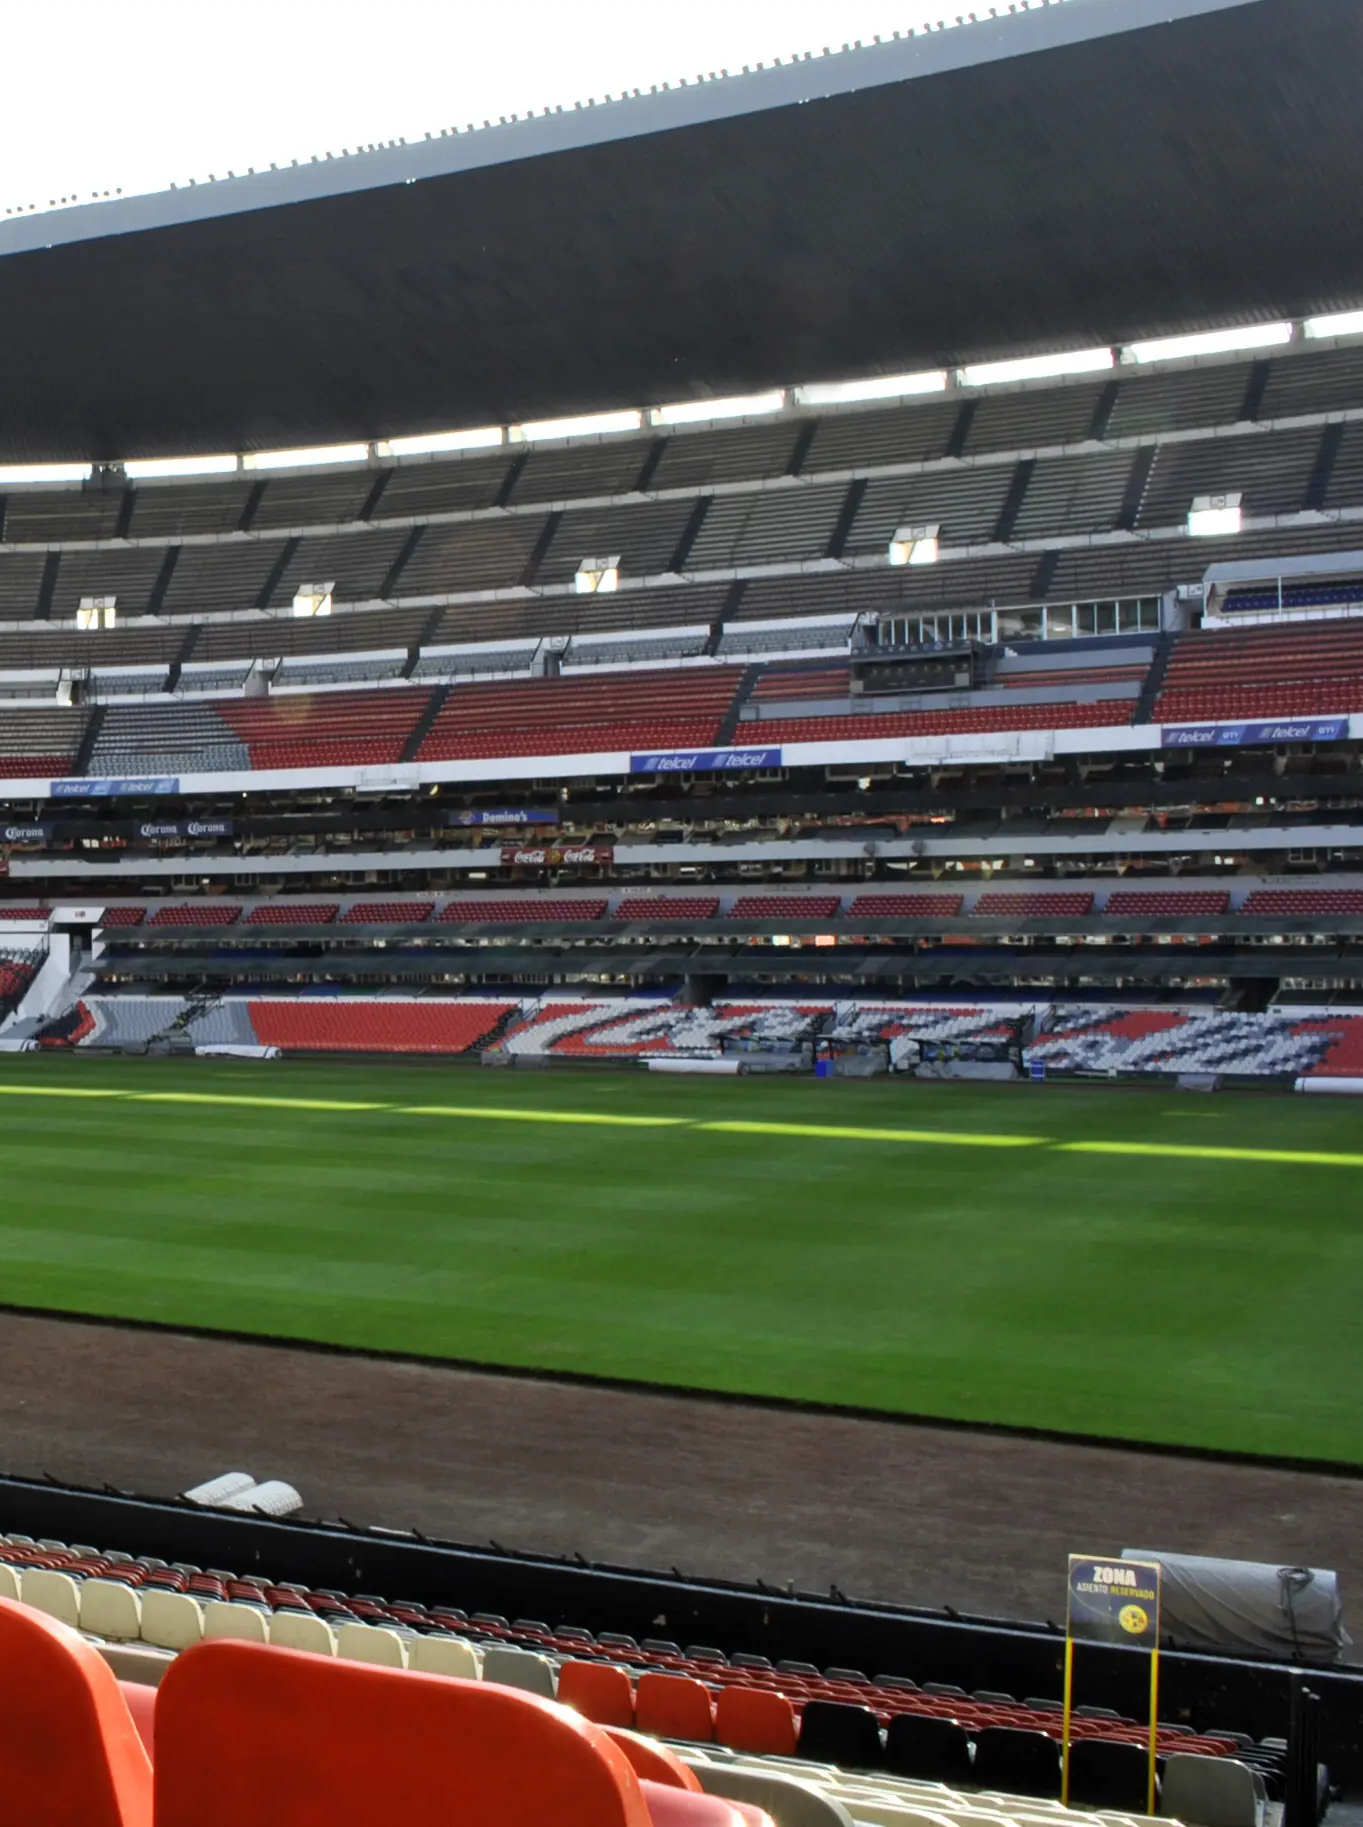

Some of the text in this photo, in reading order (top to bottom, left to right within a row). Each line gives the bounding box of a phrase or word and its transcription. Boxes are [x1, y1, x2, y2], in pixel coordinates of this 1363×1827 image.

[1175, 731, 1215, 743] telcel
[1272, 725, 1311, 739] telcel
[657, 752, 767, 770] telcel telcel
[482, 811, 528, 823] Domino's
[5, 826, 44, 841] Corona
[140, 822, 225, 837] Corona Corona
[1093, 1566, 1137, 1588] ZONA
